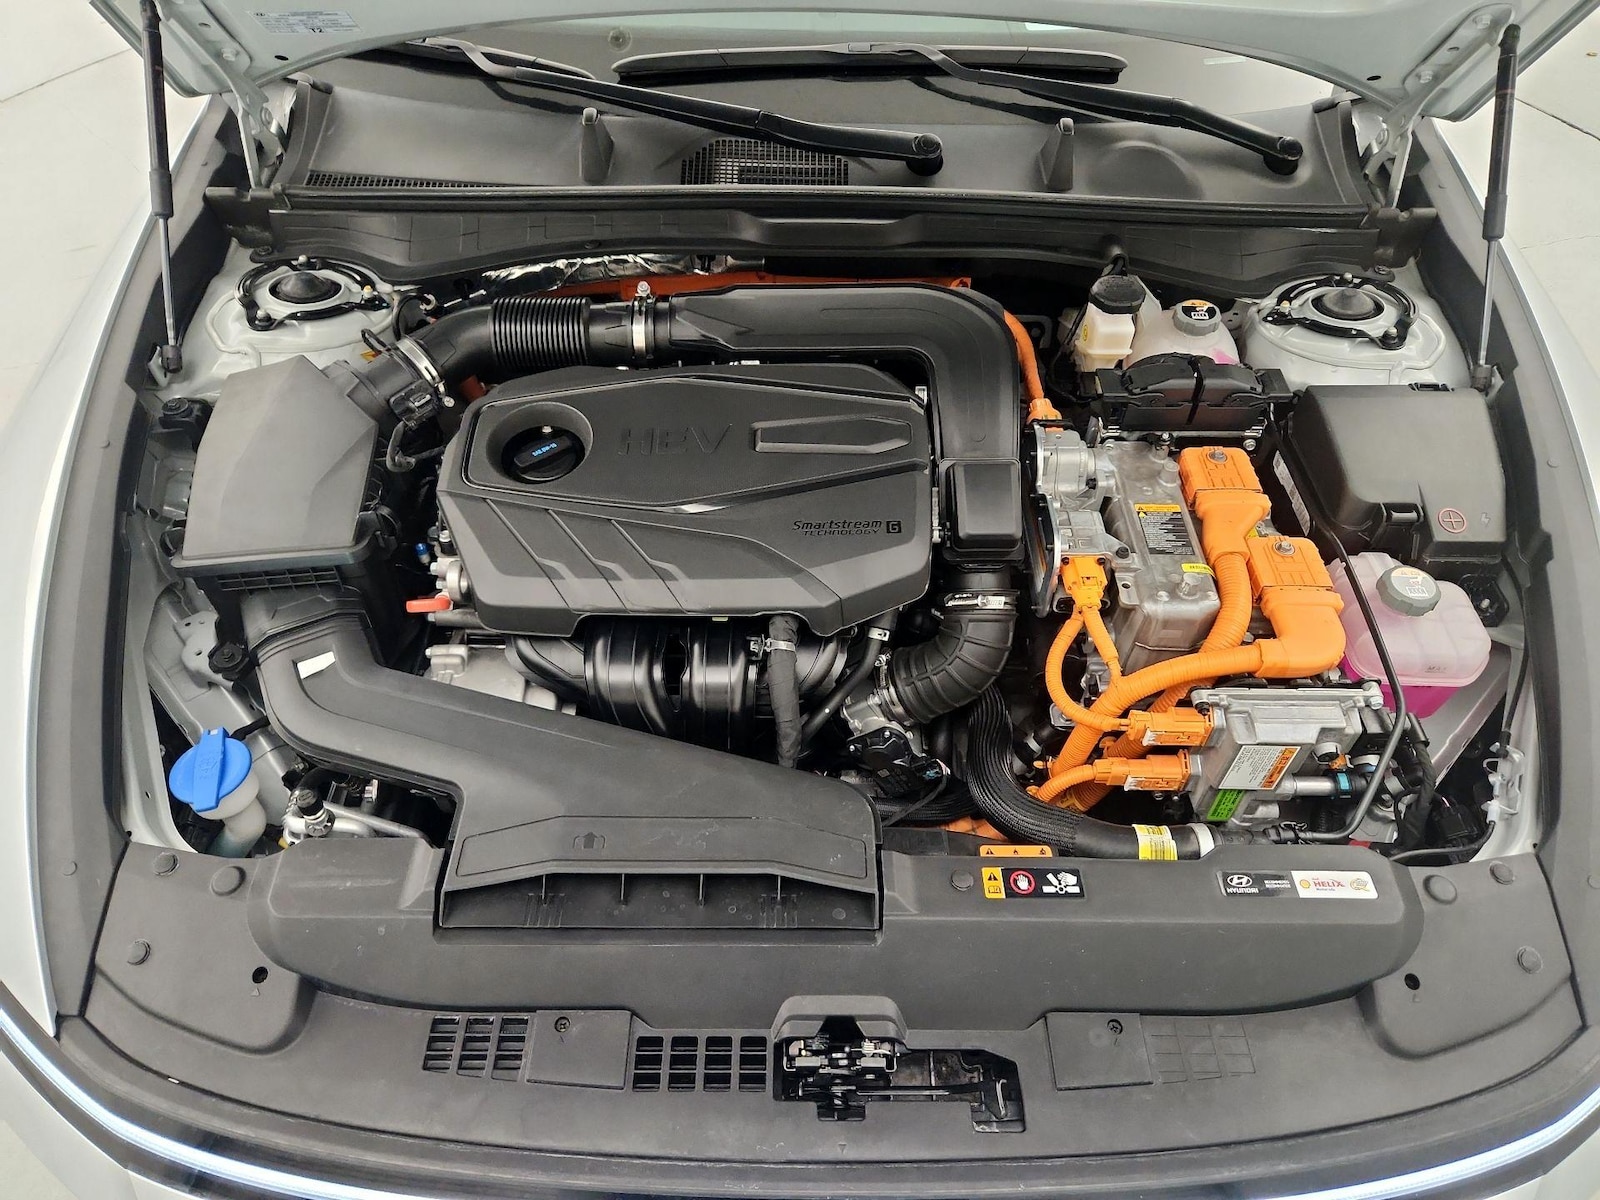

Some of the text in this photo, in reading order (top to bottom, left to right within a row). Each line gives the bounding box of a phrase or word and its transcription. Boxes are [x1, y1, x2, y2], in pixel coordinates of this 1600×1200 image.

[617, 424, 733, 456] HEV
[792, 519, 883, 531] Smartstream
[803, 528, 880, 537] TECHNOLOGY
[1313, 878, 1346, 888] HELIX
